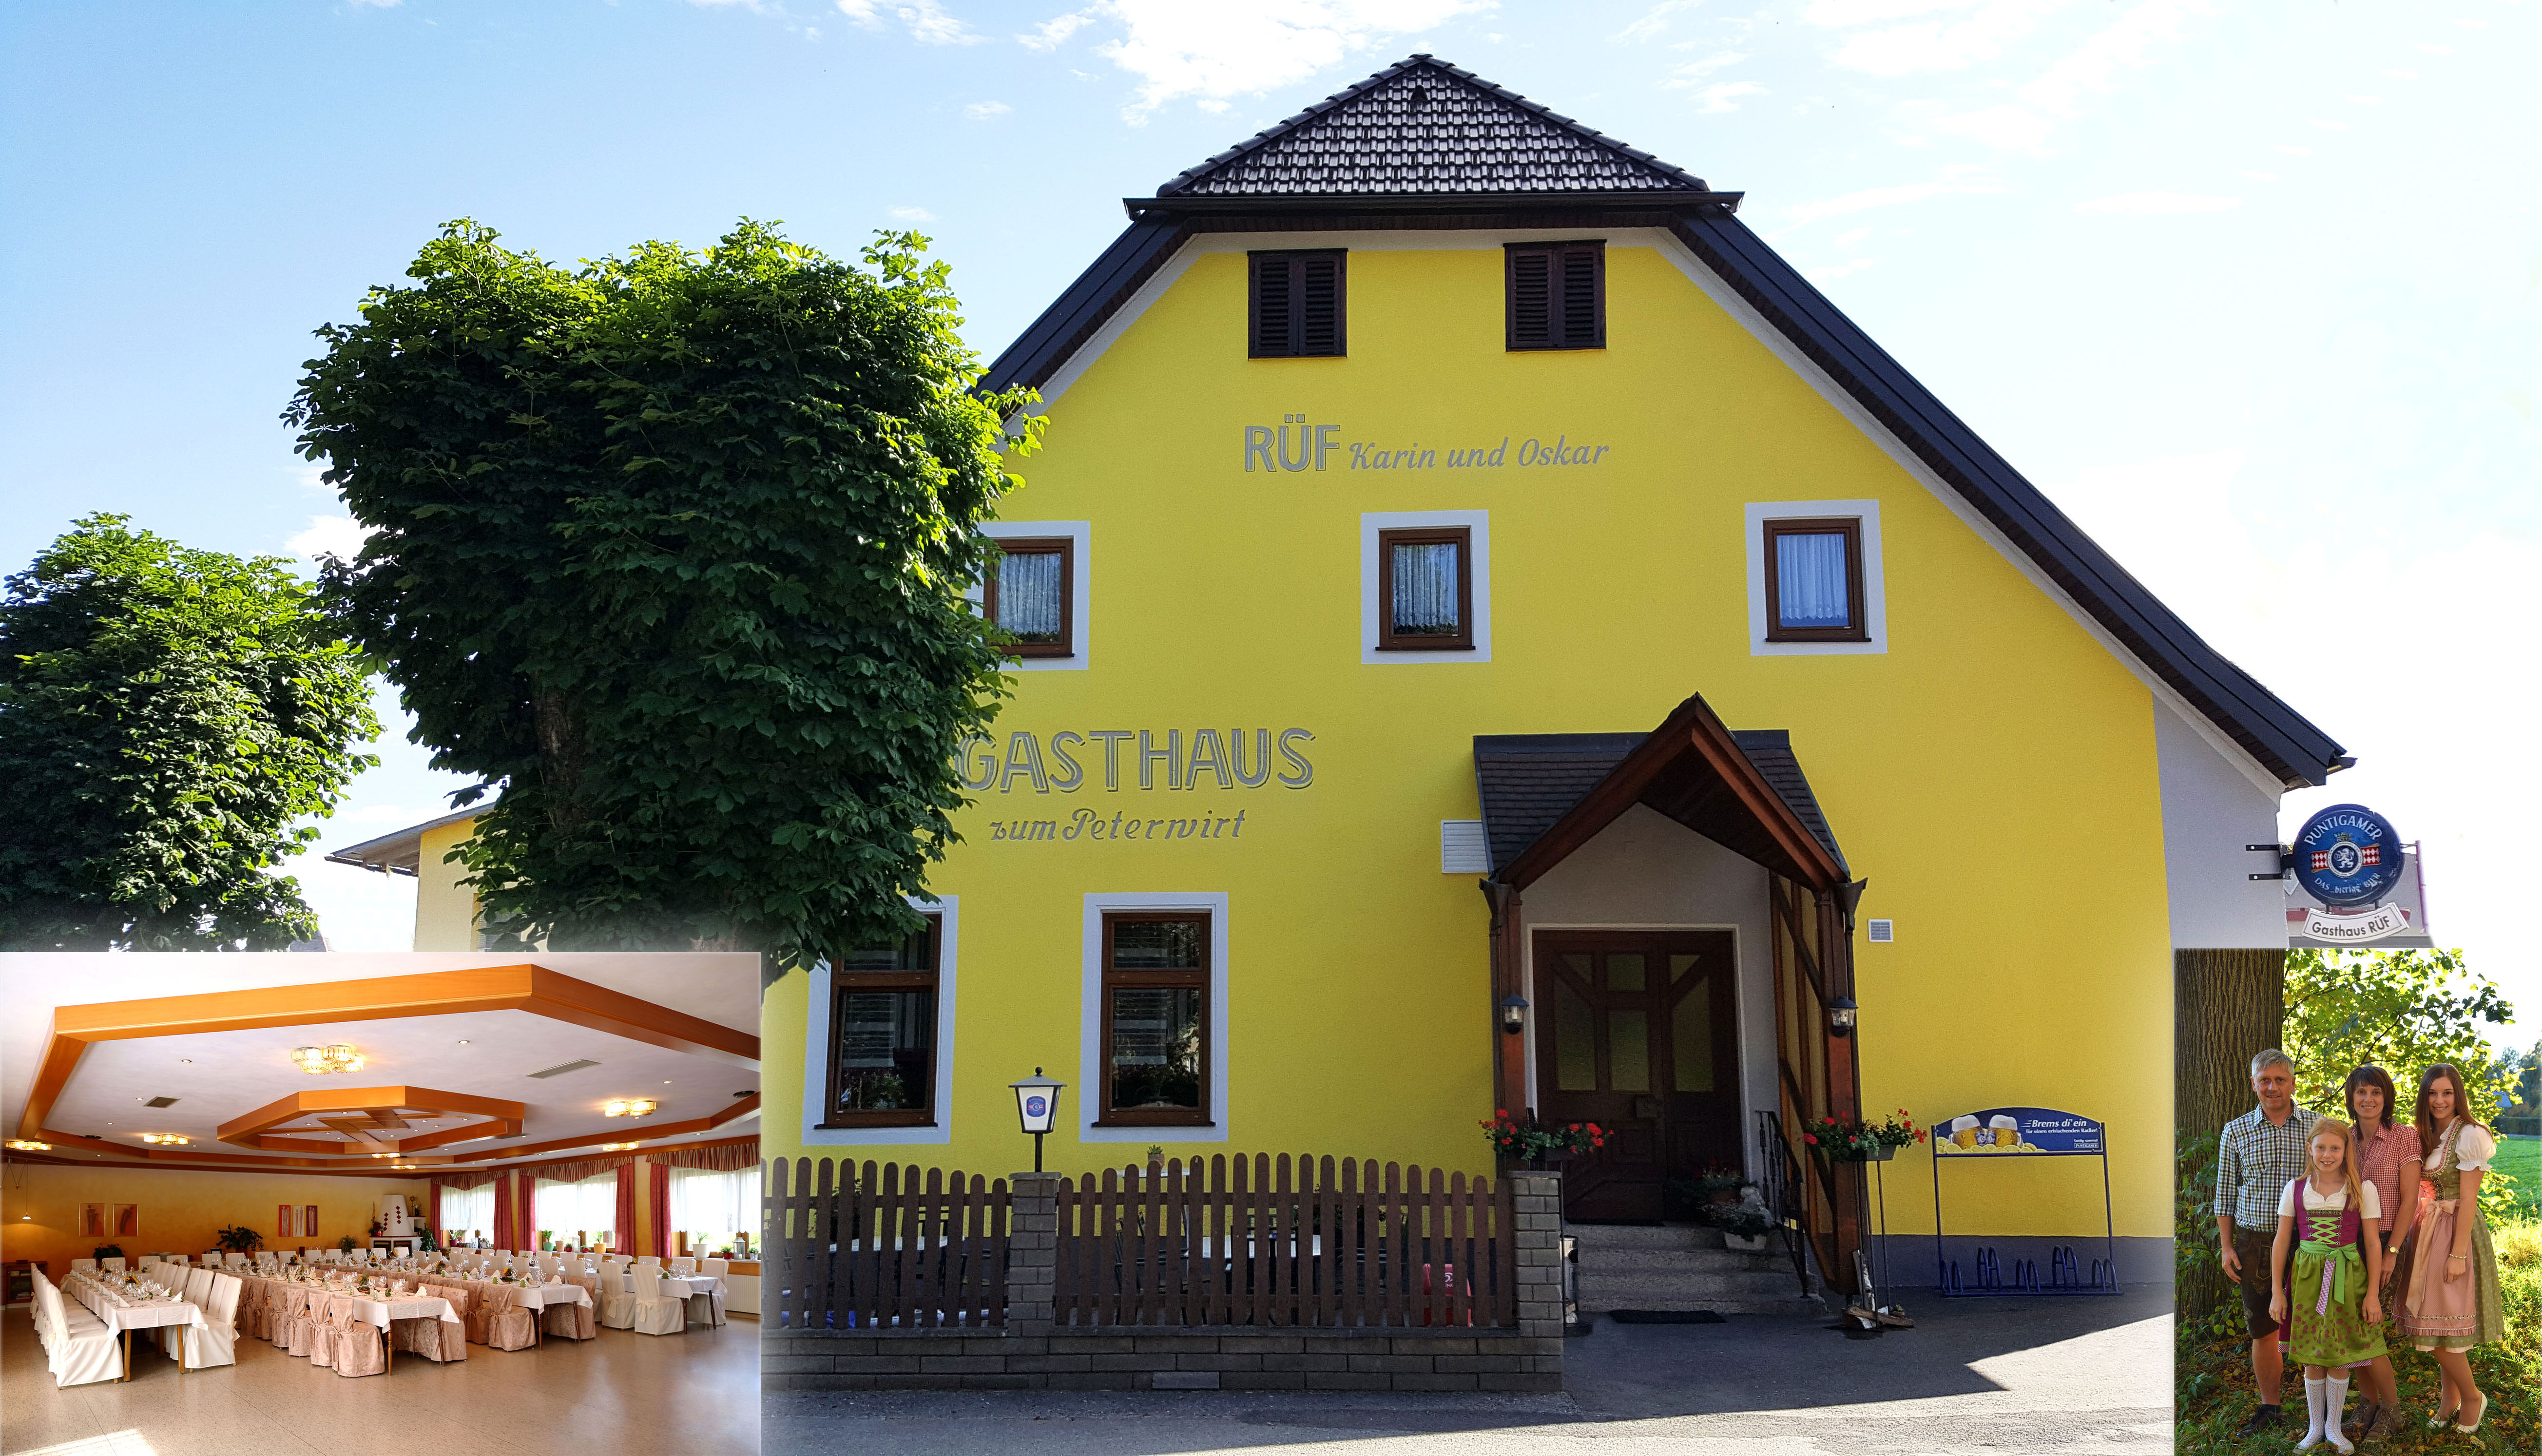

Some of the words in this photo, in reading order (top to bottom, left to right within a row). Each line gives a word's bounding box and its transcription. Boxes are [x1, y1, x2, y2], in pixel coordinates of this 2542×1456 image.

[1244, 414, 1340, 472] RÜF
[1349, 442, 1435, 469] Karin
[1447, 436, 1508, 467] und
[1518, 435, 1610, 466] Oskar
[955, 728, 1316, 794] GASTHAUS
[989, 820, 1057, 841] zum
[1061, 808, 1246, 841] Peterwirt
[2304, 814, 2383, 845] PUNTIGAMER
[2314, 877, 2330, 890] DAS
[2312, 921, 2366, 937] Gasthaus
[2368, 915, 2390, 933] RÜF
